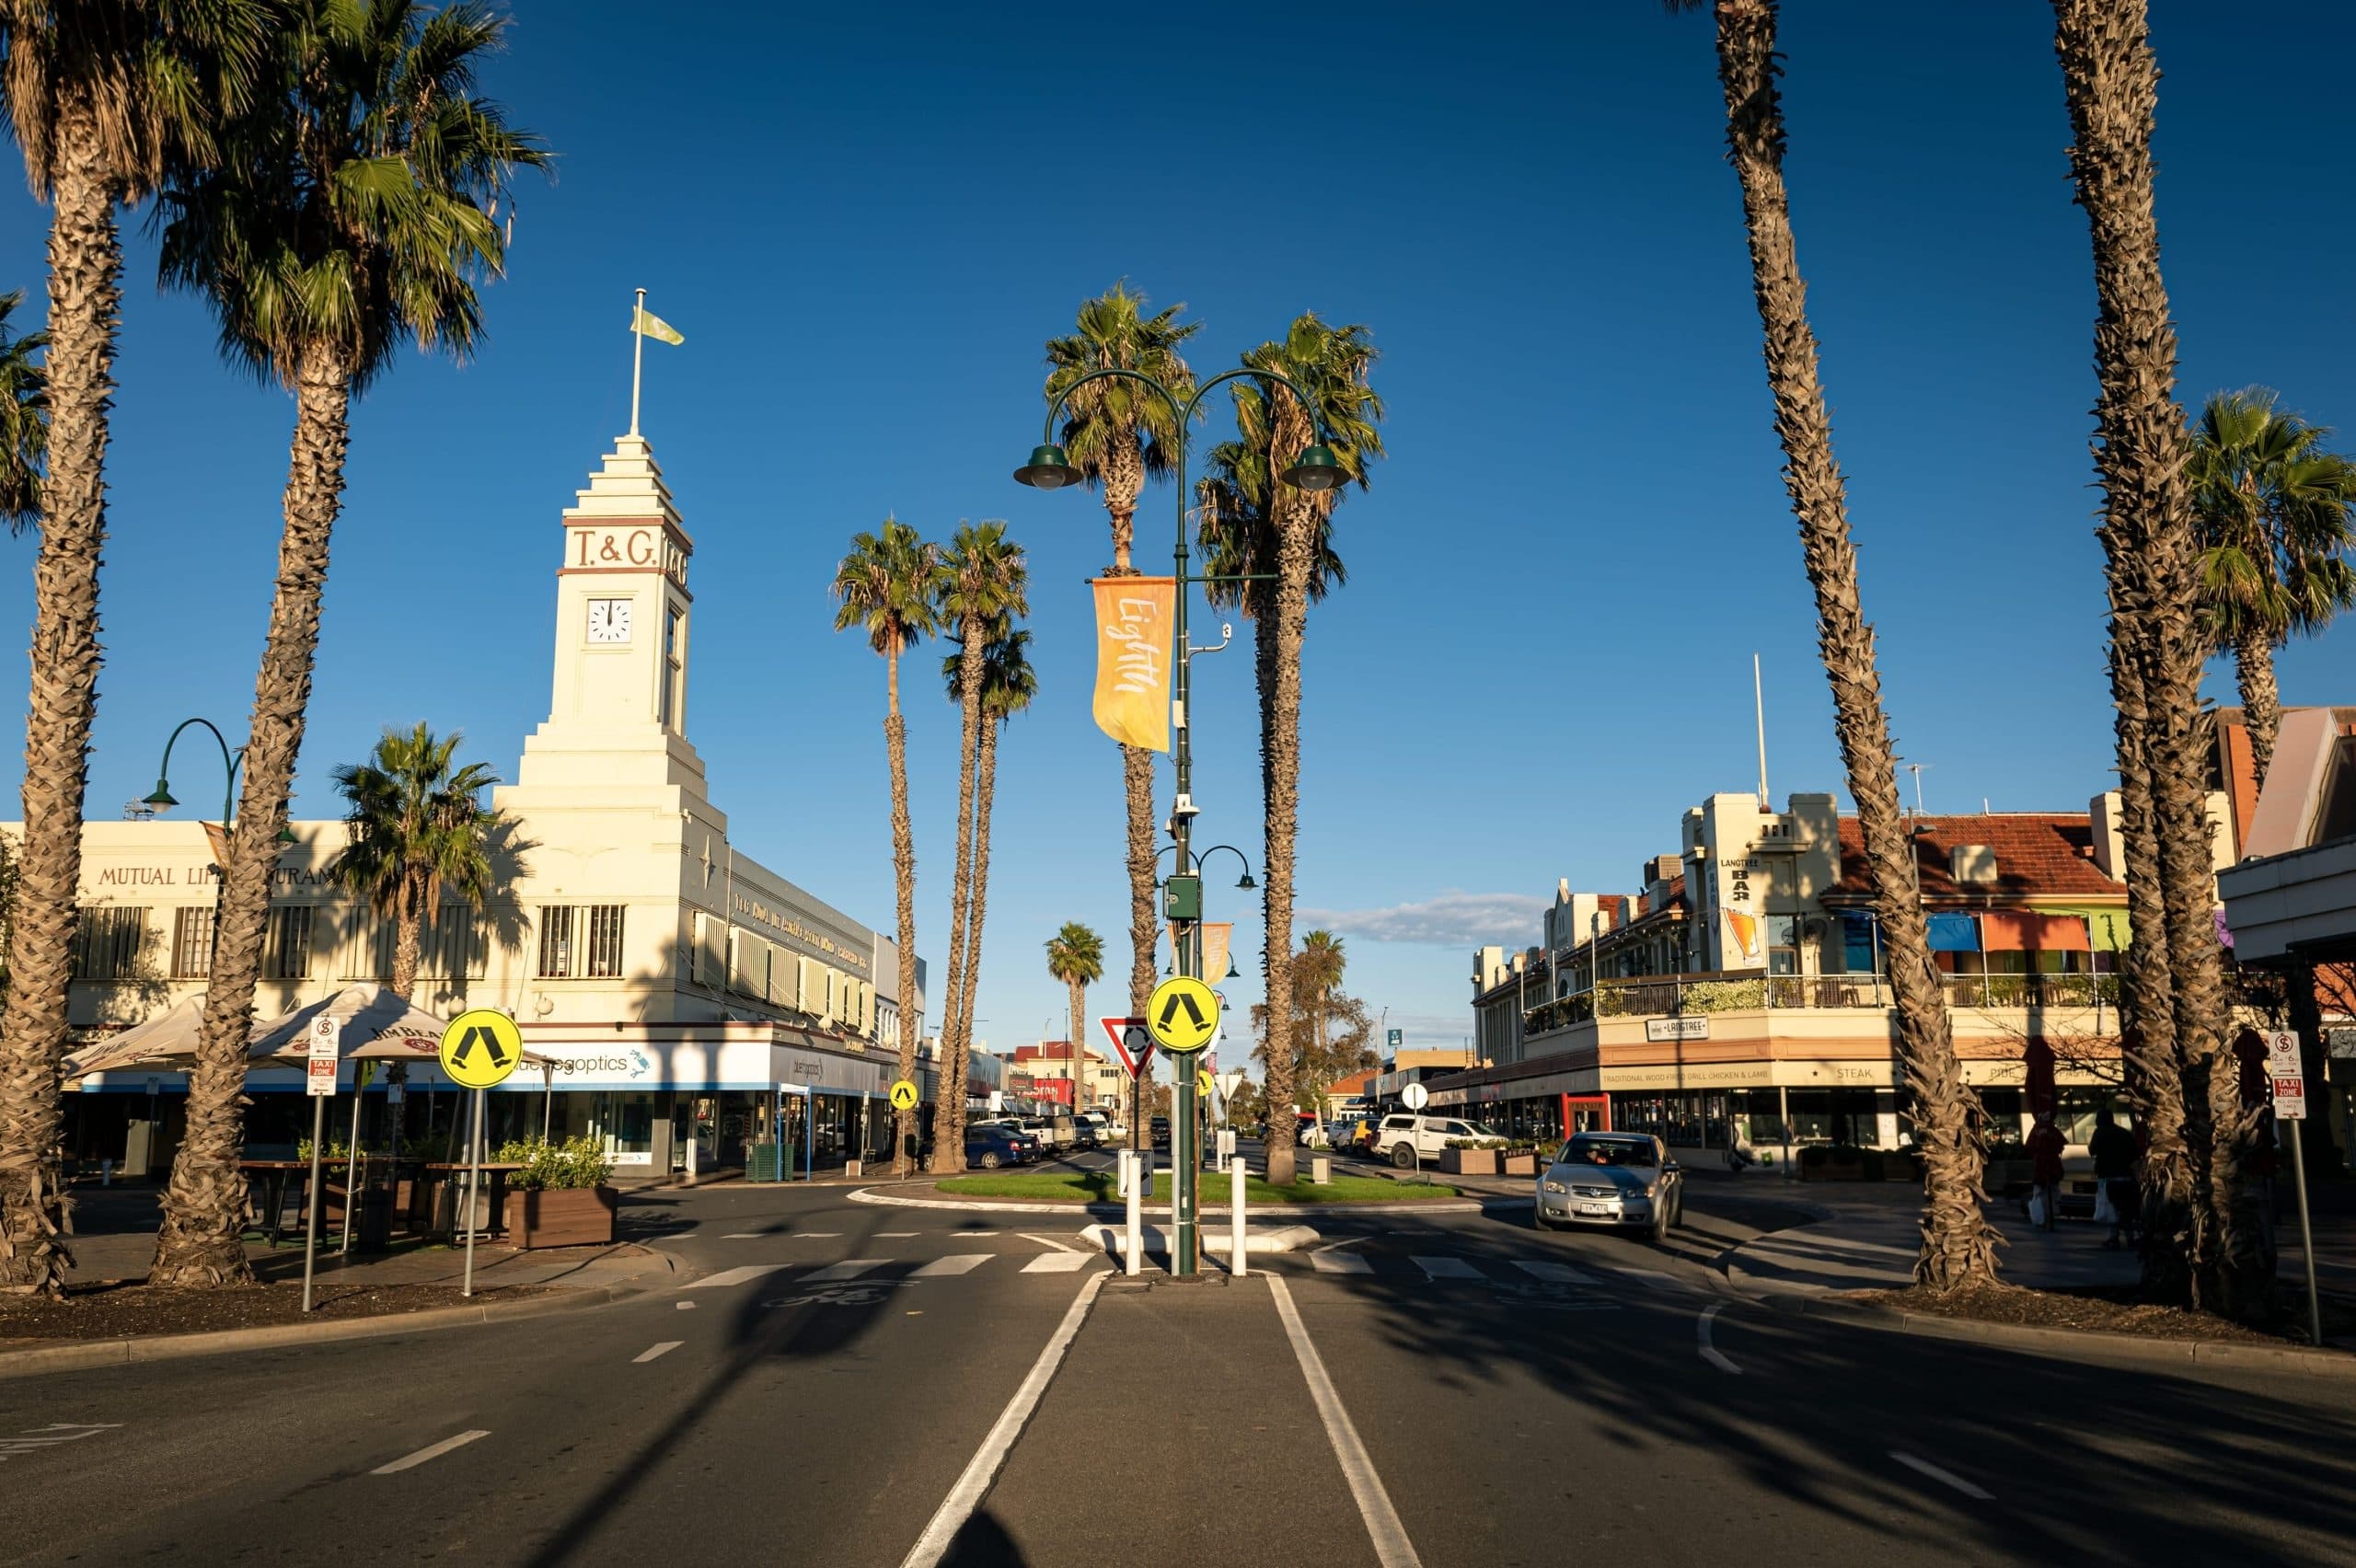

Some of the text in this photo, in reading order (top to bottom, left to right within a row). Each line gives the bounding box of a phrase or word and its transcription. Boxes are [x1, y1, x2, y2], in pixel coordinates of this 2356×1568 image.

[1105, 598, 1161, 693] Eighth
[1721, 859, 1759, 868] LANGTREE
[98, 868, 176, 885] MUTUAL
[1732, 870, 1750, 901] BAR
[1667, 1020, 1702, 1032] LANGTREE
[398, 1025, 444, 1040] BEA
[313, 1067, 332, 1076] ZONE
[1604, 1075, 1644, 1083] TRADITIONAL
[1749, 1070, 1768, 1078] LAMB
[1837, 1068, 1873, 1078] STEAK
[2277, 1079, 2299, 1088] TAXI
[2279, 1088, 2298, 1096] ZONE
